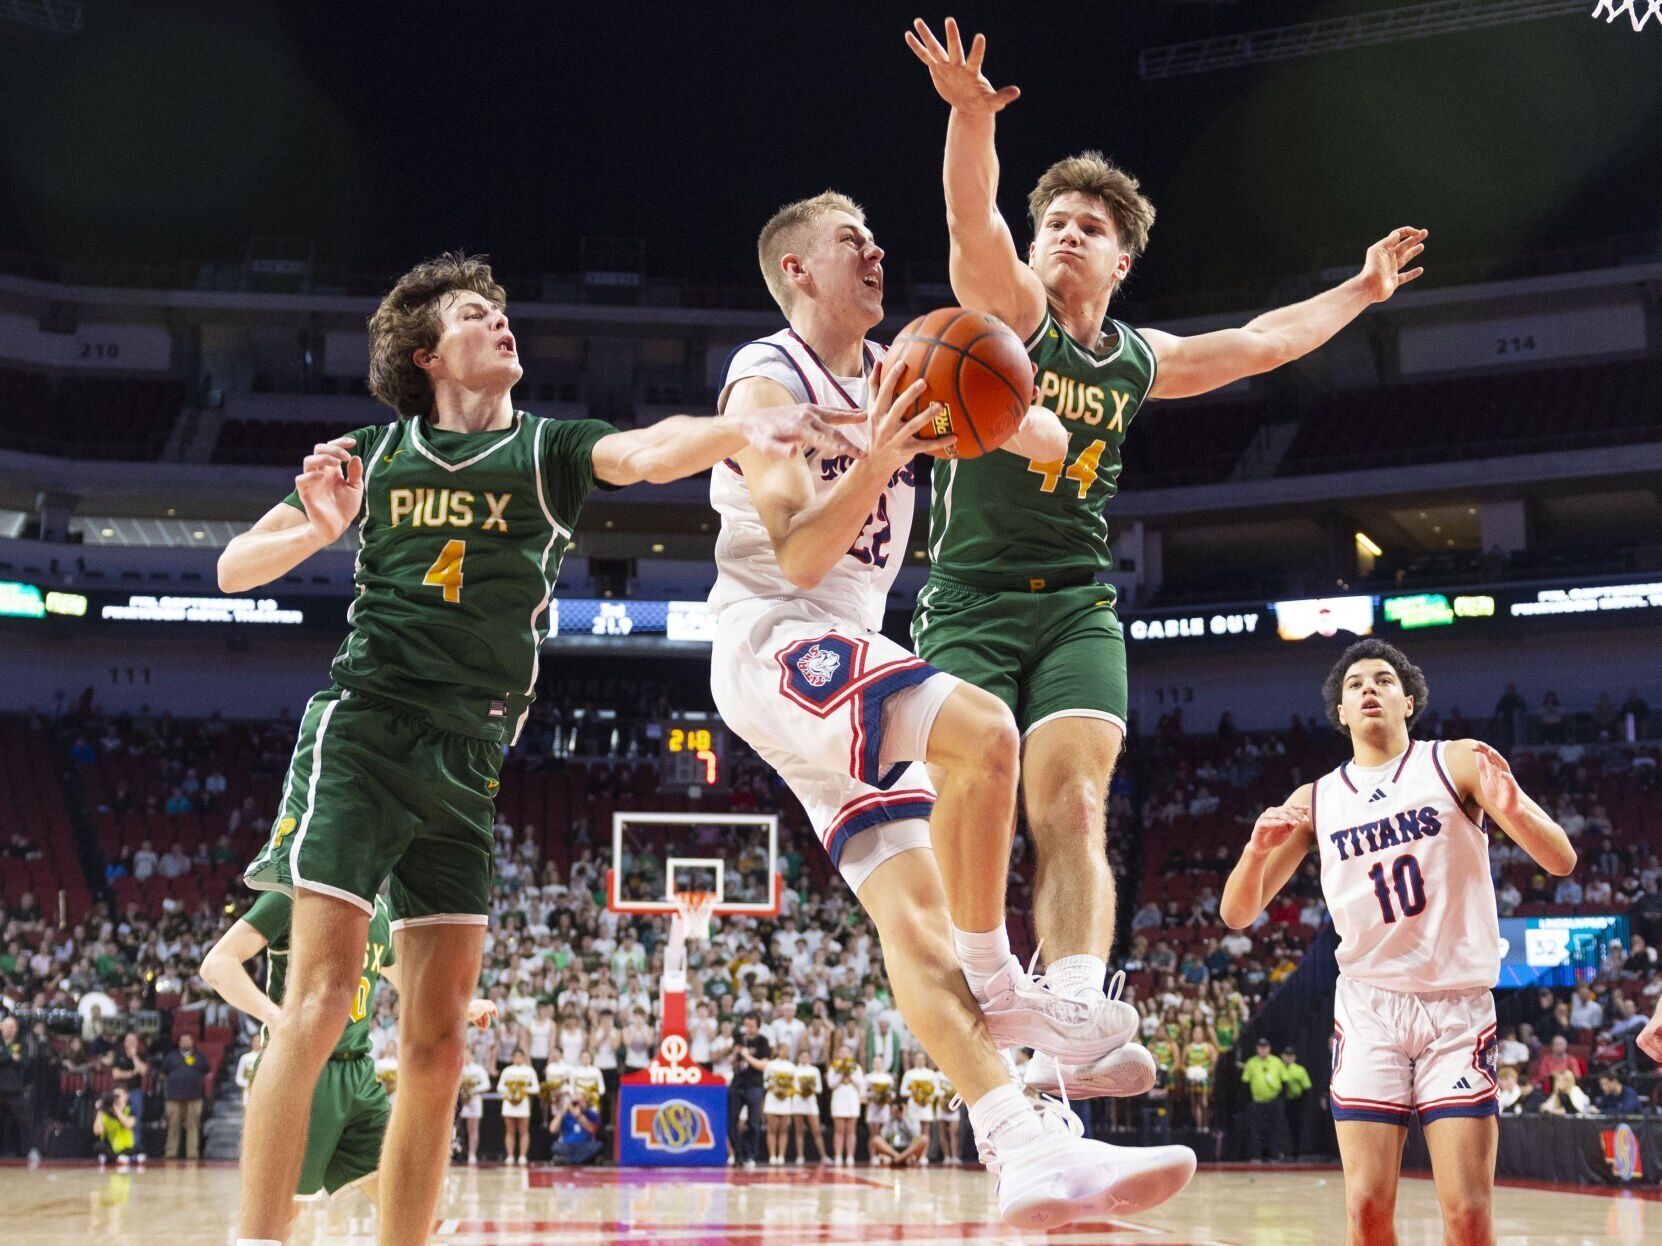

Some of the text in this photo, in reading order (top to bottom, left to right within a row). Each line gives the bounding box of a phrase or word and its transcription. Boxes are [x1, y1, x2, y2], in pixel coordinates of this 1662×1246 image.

[80, 343, 119, 358] 210
[1497, 336, 1535, 354] 214
[1034, 370, 1105, 426] PIUS
[1105, 389, 1130, 433] X
[390, 488, 513, 533] PIUS X
[422, 539, 466, 604] 4
[1210, 613, 1259, 635] GUY
[109, 668, 150, 683] 111
[1155, 687, 1194, 704] 113
[696, 750, 716, 784] 7
[1330, 806, 1442, 861] TITANS
[1368, 854, 1427, 925] 10
[649, 1060, 702, 1085] fnbo
